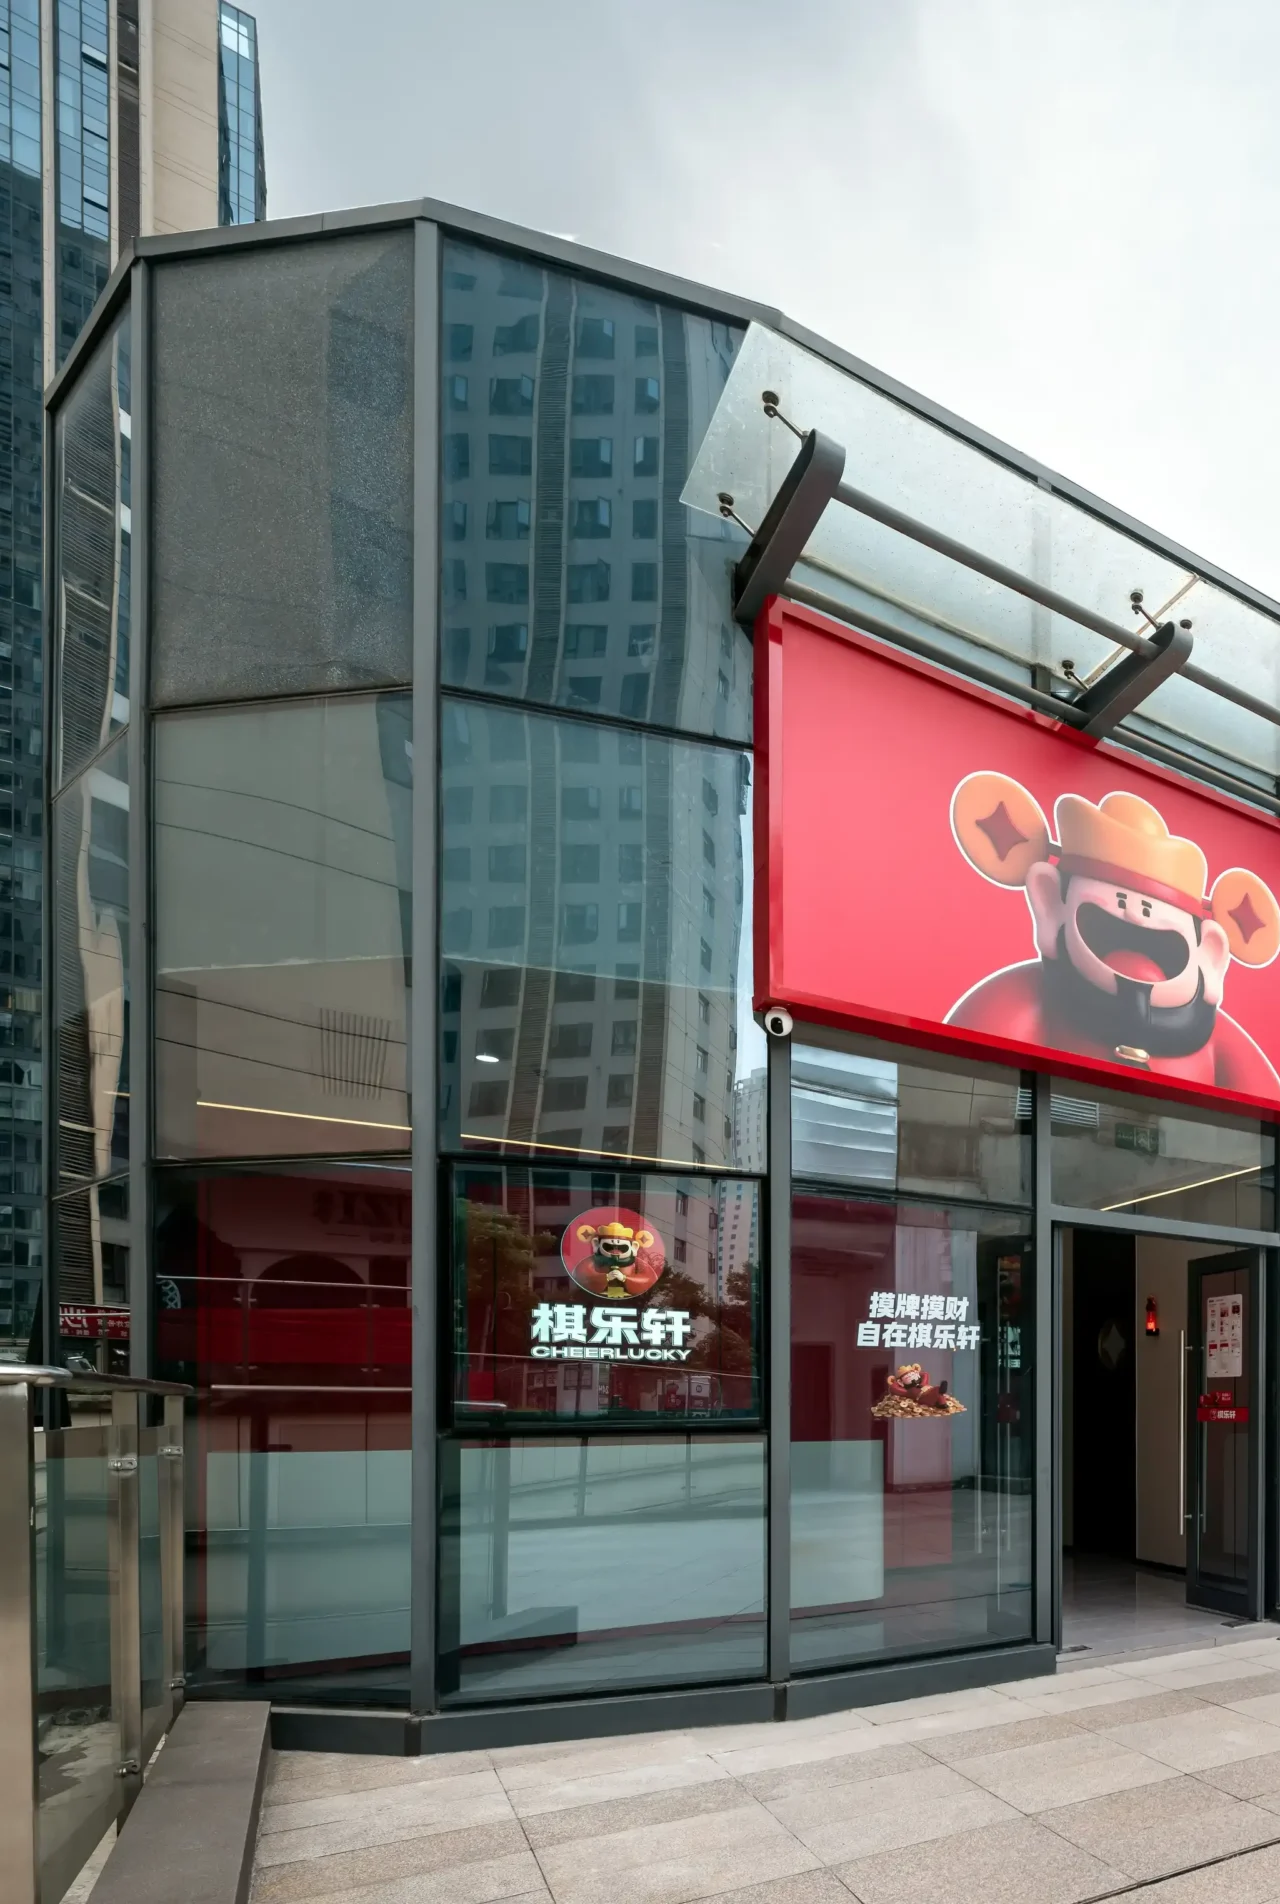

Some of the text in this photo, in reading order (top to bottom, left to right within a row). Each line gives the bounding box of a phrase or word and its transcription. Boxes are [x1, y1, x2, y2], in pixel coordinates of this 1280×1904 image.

[869, 1291, 969, 1322] 摸牌摸财
[531, 1302, 691, 1347] 棋乐轩
[856, 1321, 981, 1350] 自在棋乐轩
[530, 1345, 692, 1361] CHEERLUCKY
